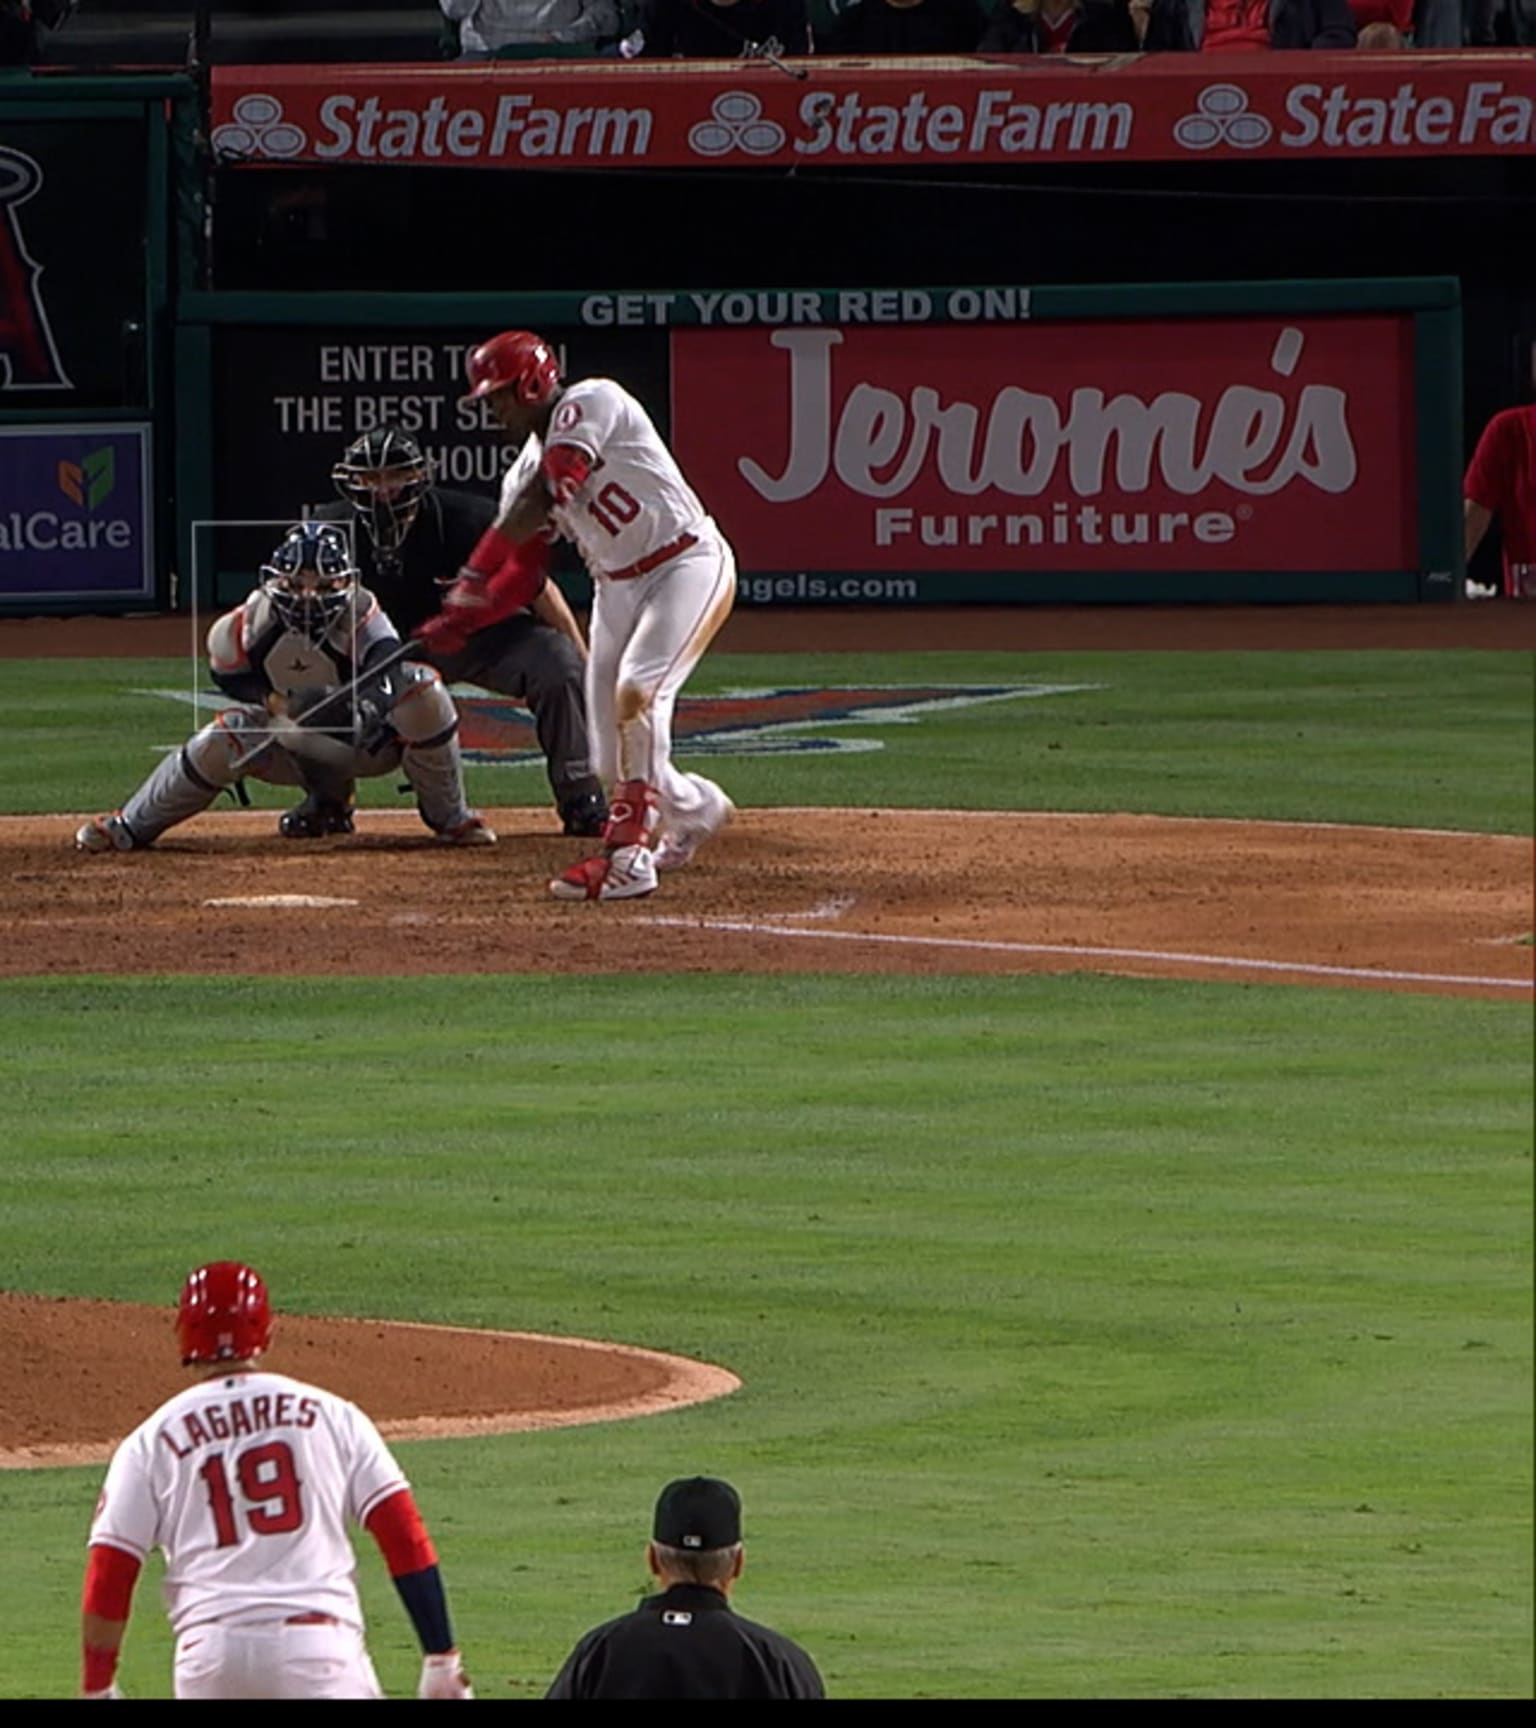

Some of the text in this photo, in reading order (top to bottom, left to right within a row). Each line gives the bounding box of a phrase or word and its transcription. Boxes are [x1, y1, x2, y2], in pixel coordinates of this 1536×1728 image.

[581, 287, 1030, 326] GET YOUR RED ON!
[320, 345, 435, 382] ENTER
[273, 395, 343, 432] THE
[354, 395, 445, 432] BEST
[589, 481, 641, 536] 10
[739, 573, 917, 603] ngels.com
[160, 1393, 320, 1459] LAGARES
[200, 1441, 303, 1549] 19
